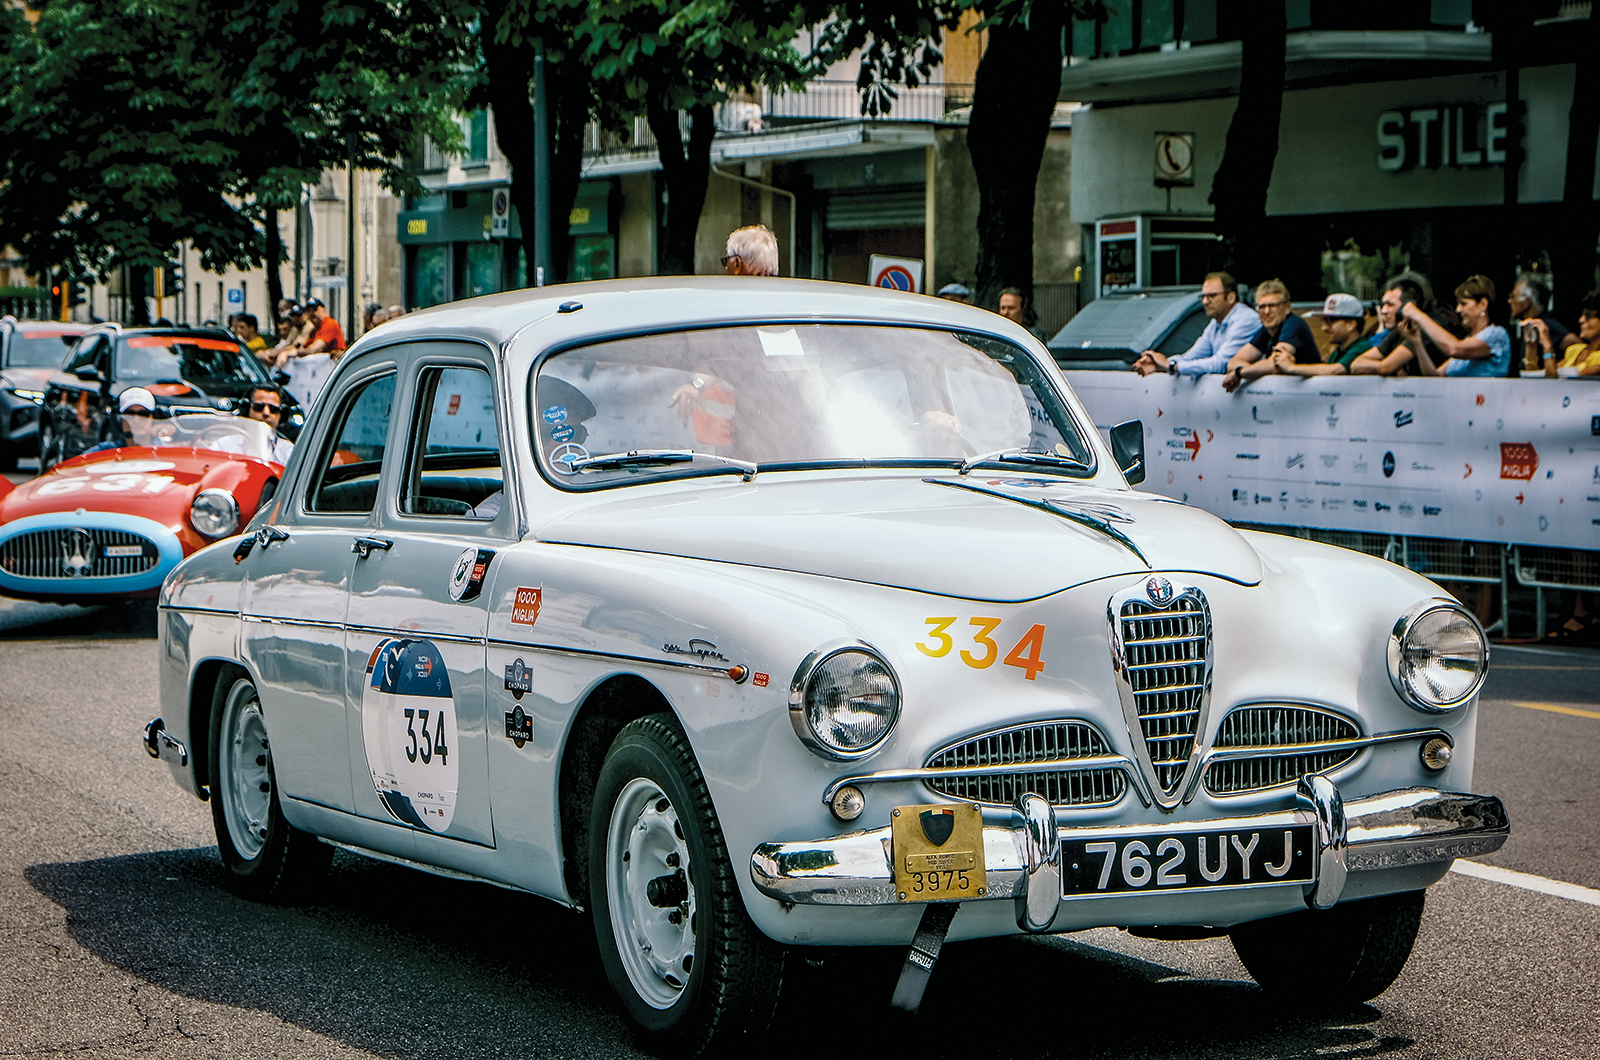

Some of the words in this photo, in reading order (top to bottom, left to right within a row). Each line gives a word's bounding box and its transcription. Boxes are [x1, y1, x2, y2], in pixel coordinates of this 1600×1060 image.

[1377, 100, 1508, 171] STILE
[1504, 446, 1530, 460] 1000
[1502, 463, 1531, 477] MIGLIA
[37, 473, 175, 495] 631
[517, 591, 537, 605] 1000
[512, 607, 535, 622] MIGLIA
[915, 616, 1046, 681] 334
[507, 682, 529, 691] CHOPARD
[403, 708, 448, 766] 334
[509, 730, 530, 739] CHOPARD
[1085, 838, 1187, 890] 762
[1197, 830, 1293, 882] UYJ
[912, 869, 970, 893] 3975
